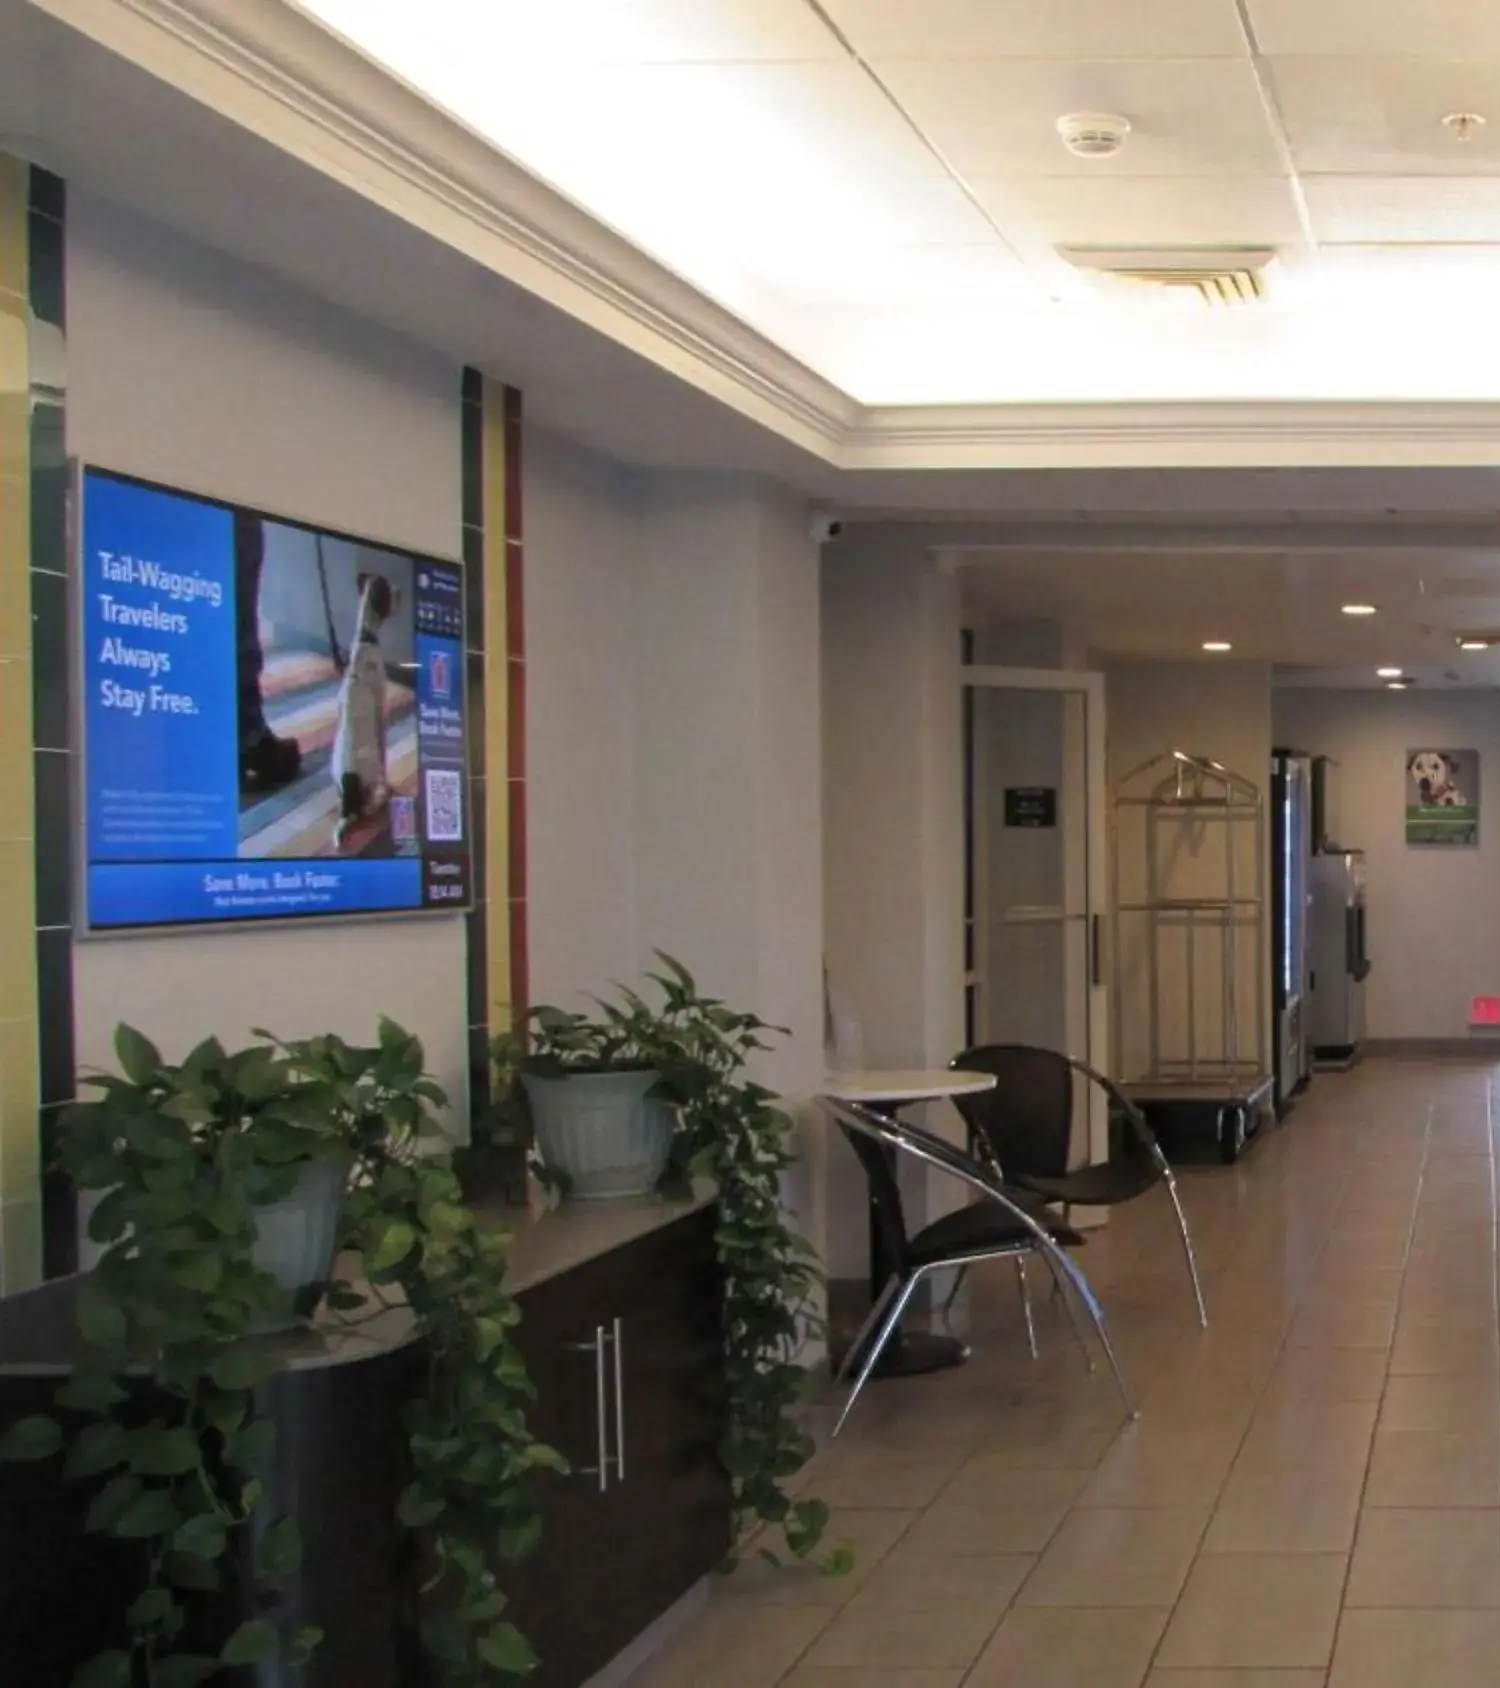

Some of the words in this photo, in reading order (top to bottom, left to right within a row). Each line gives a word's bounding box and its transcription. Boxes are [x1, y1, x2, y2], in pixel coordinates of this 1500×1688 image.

[97, 550, 222, 608] Tail-Wagging
[98, 593, 188, 634] Travelers
[100, 637, 171, 678] Always
[100, 679, 146, 718] Stay
[150, 685, 200, 714] Free.
